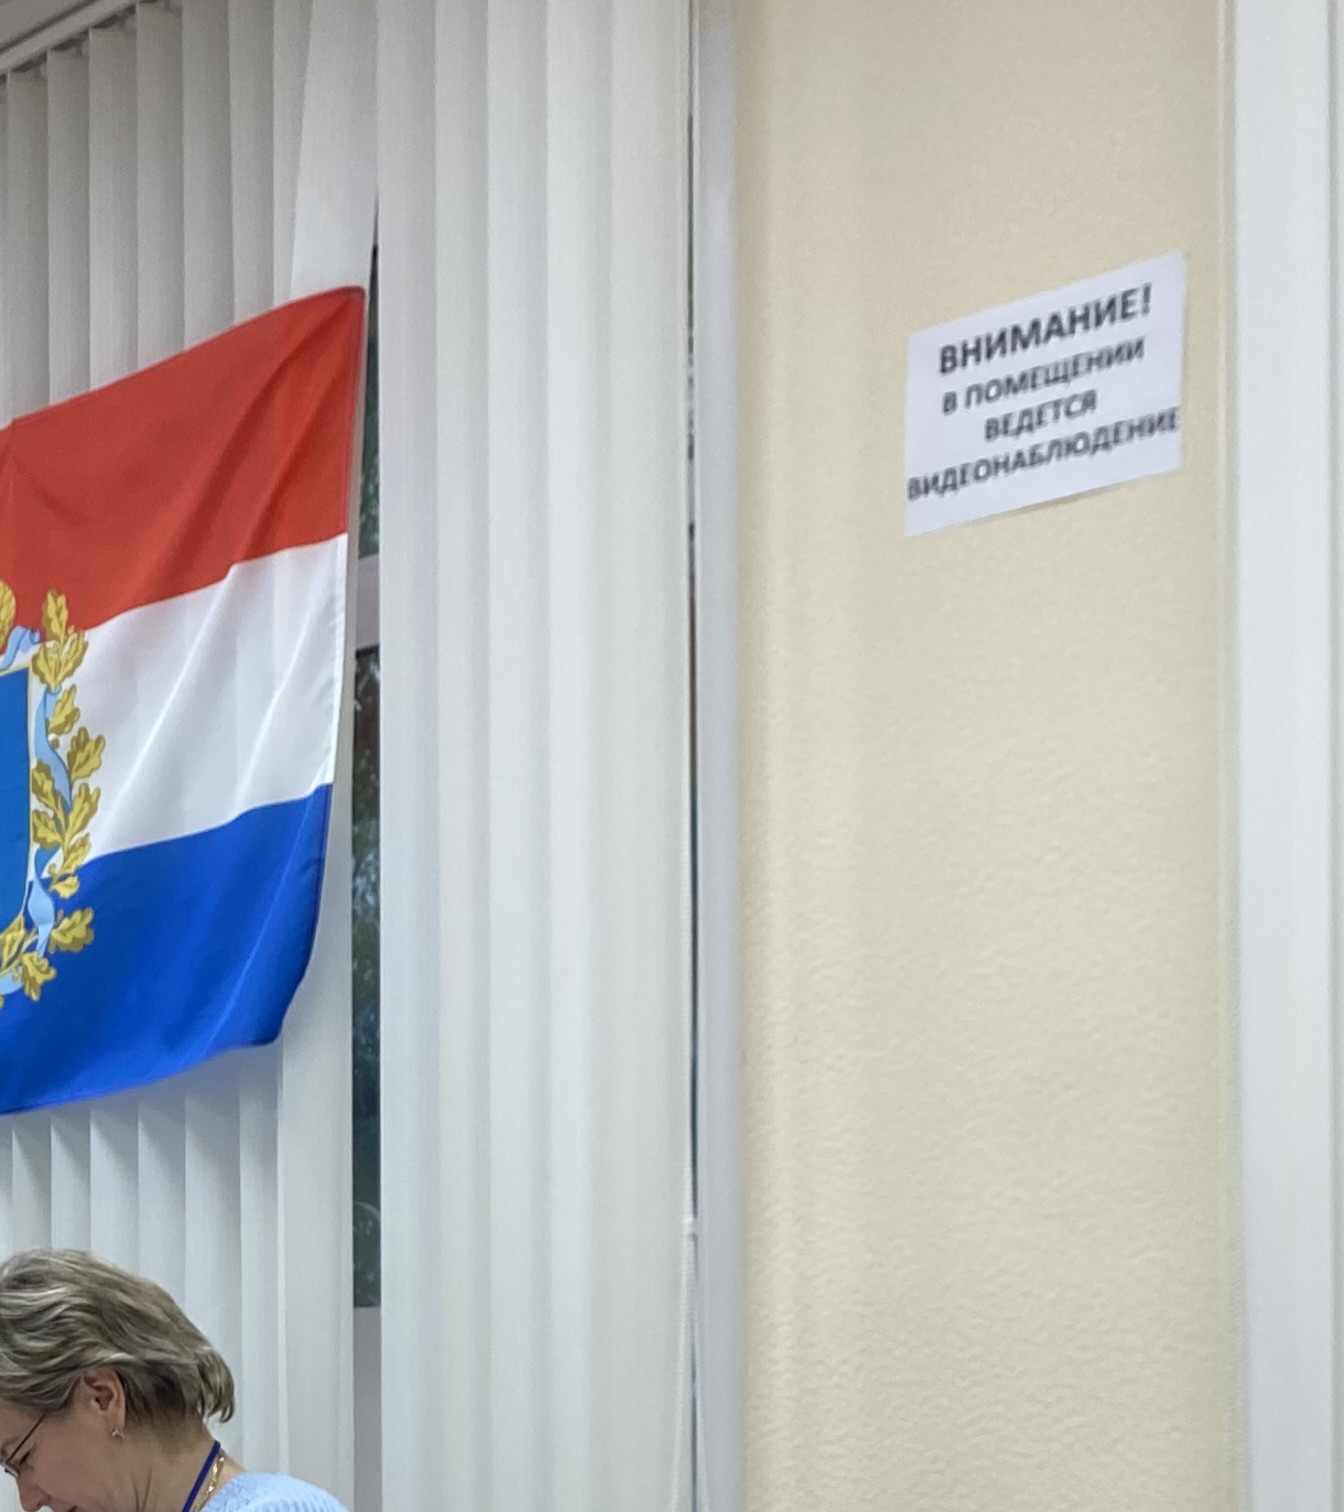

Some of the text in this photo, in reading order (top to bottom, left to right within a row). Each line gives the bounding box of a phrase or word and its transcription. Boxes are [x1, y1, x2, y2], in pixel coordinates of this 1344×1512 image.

[938, 282, 1152, 375] ВНИМАНИЕ!
[942, 335, 1146, 416] В ПОМЕЩЕНИИ
[984, 389, 1098, 442] ВЕДЕТСЯ
[907, 406, 1180, 501] ВИДЕОНАБЛЮДЕНИЕ
